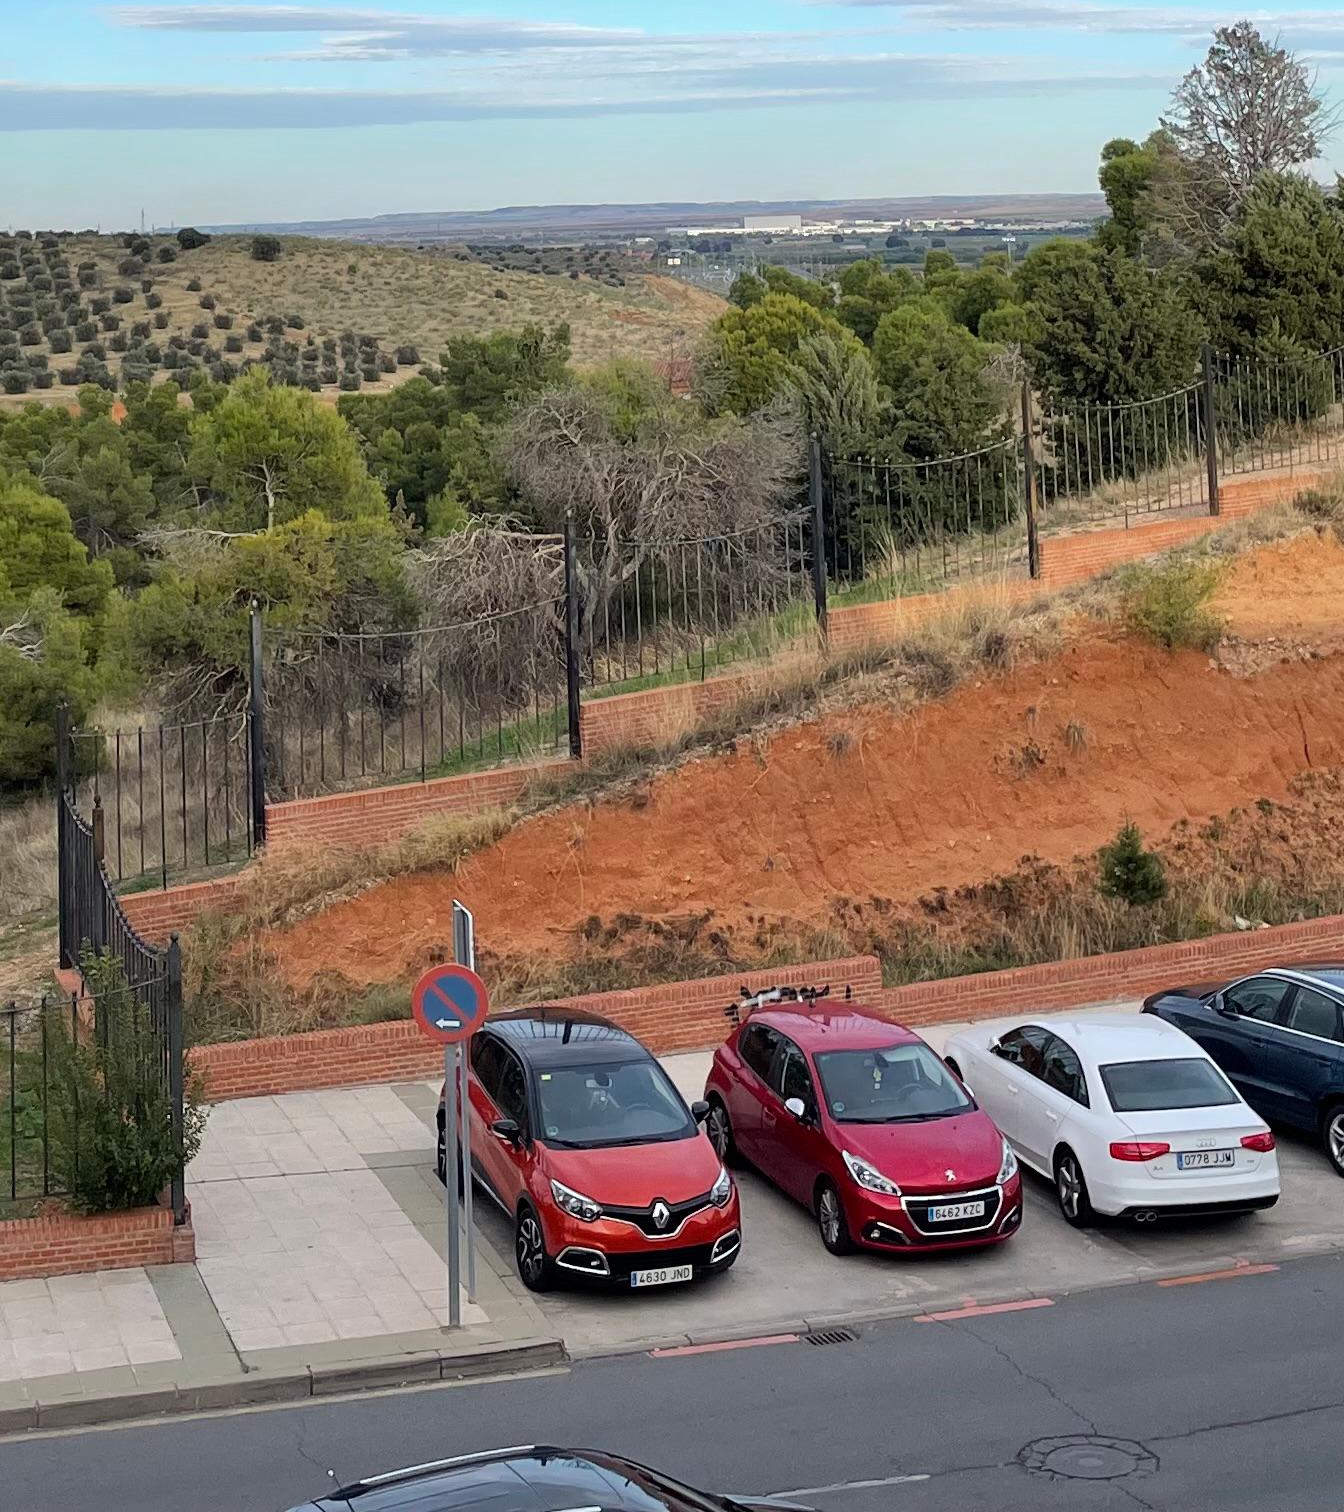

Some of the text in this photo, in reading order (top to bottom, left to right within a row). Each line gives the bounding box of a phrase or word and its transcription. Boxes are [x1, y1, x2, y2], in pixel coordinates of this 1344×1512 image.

[1184, 1153, 1209, 1166] 0778
[935, 1203, 981, 1220] 6462 KZC
[639, 1267, 690, 1283] 4630 JND
